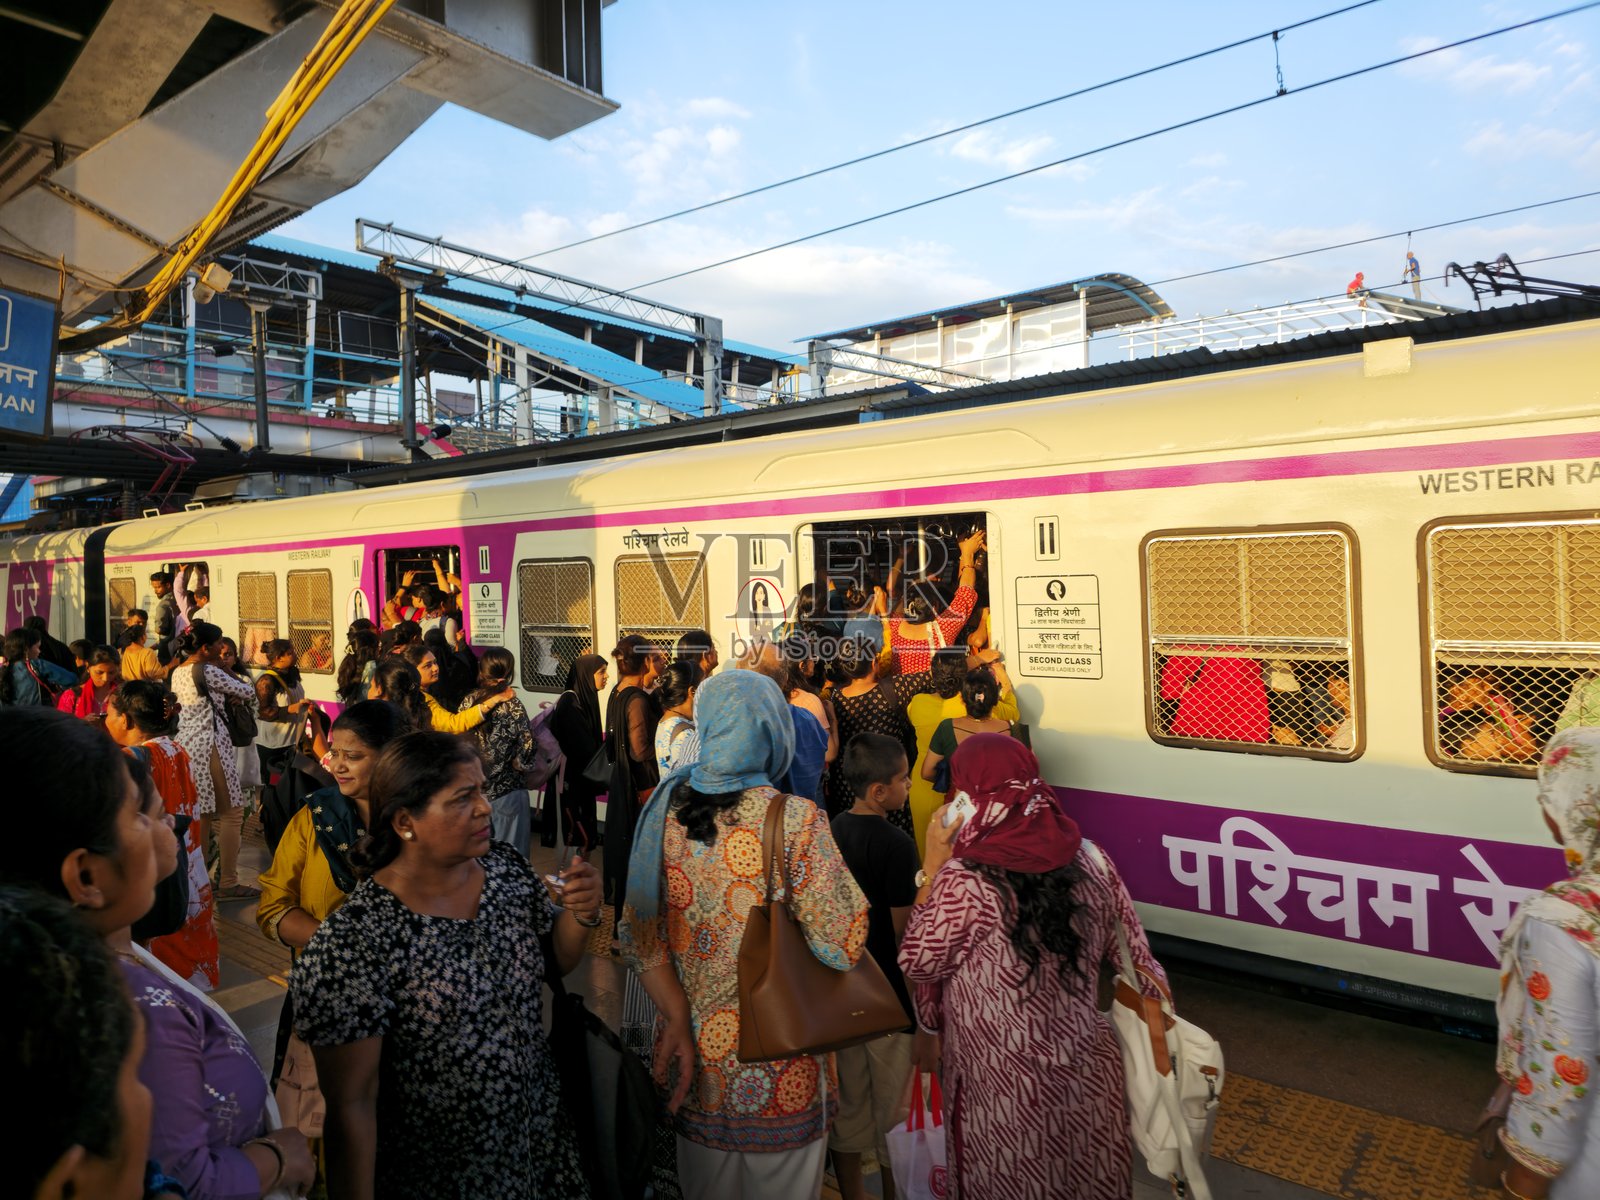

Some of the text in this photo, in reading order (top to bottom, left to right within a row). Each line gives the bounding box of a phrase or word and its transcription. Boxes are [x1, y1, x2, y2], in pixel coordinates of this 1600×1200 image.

[0, 393, 35, 414] AN
[1418, 465, 1555, 495] WESTERN
[623, 526, 689, 550] पश्चिम रेलवे
[288, 549, 331, 561] WESTERN RAILWAY
[1034, 606, 1080, 617] द्वितीय श्रेणी
[1038, 631, 1080, 643] दूसरा दर्जा
[1029, 656, 1092, 665] SECOND CLASS
[1162, 816, 1545, 964] पश्चिम रे
